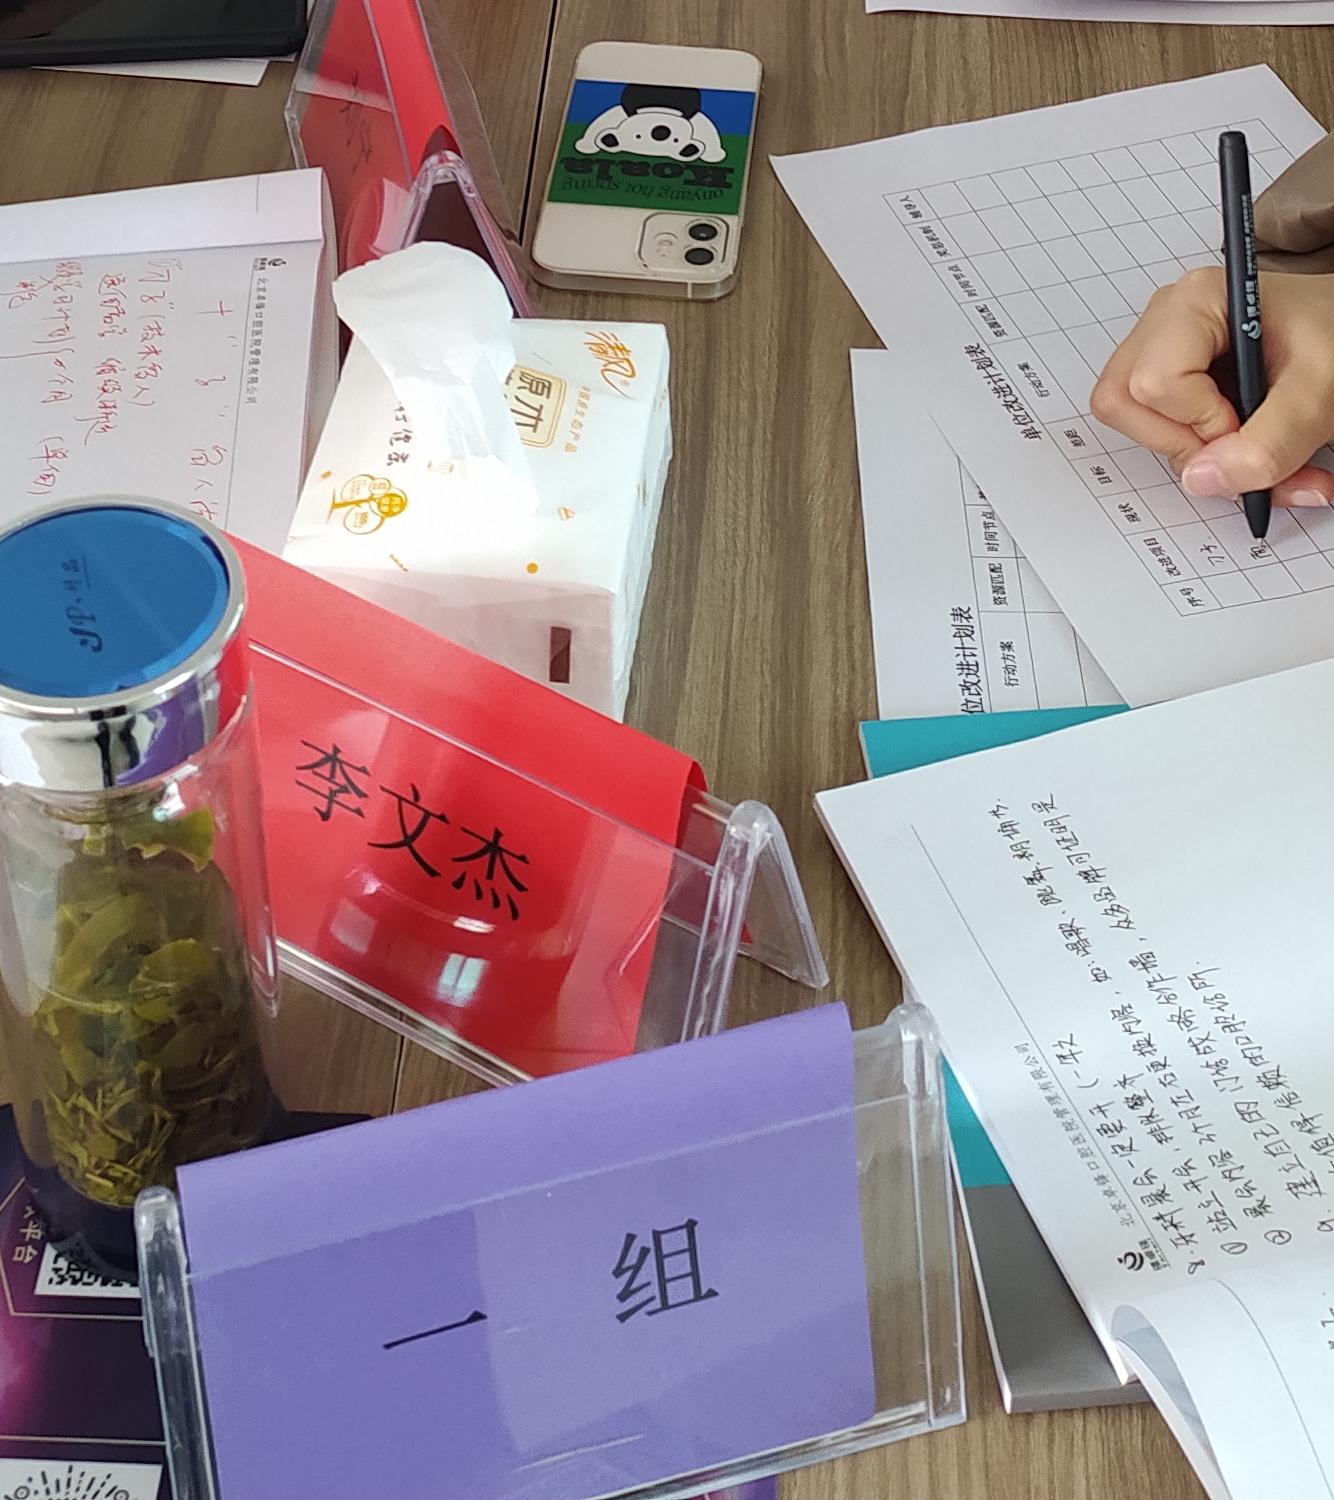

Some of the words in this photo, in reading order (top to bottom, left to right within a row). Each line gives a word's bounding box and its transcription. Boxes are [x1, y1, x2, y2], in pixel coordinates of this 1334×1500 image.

[560, 155, 735, 190] Koala
[624, 182, 654, 198] hot
[948, 263, 979, 299] 时间节点
[973, 303, 1009, 339] 资源匹配
[963, 342, 1044, 442] 单位改进计划表
[1017, 361, 1052, 399] 行动方案
[510, 371, 553, 434] 原木
[1089, 464, 1113, 487] 目标
[985, 508, 1001, 554] 时间节点
[1117, 501, 1142, 525] 现状
[1142, 536, 1183, 579] 改进项目
[990, 561, 1009, 607] 资源匹配
[1179, 586, 1205, 609] 序号
[950, 605, 985, 715] 位改进计划表
[1002, 639, 1019, 689] 行动方案
[294, 737, 534, 922] 李文杰
[1013, 1042, 1137, 1228] 北京卓锋口腔医院管理有限公司
[381, 1308, 488, 1351] 一
[610, 1216, 719, 1327] 组
